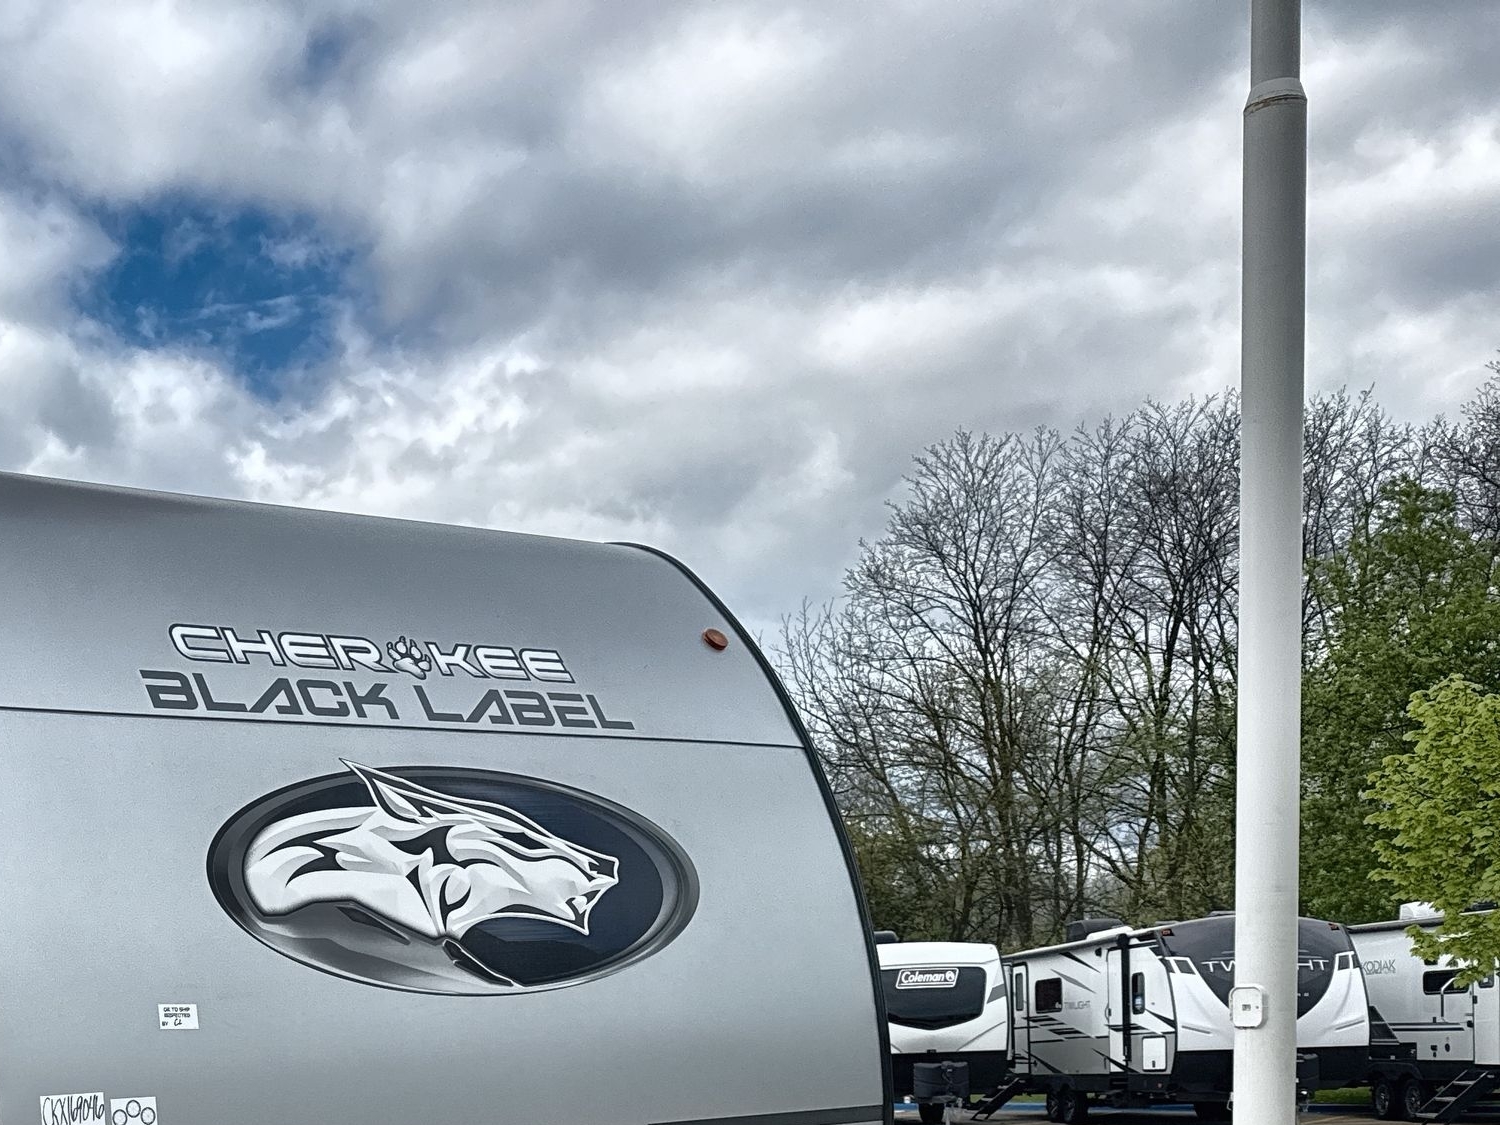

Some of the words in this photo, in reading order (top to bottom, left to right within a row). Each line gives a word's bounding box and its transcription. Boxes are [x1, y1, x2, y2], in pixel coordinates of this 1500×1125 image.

[139, 669, 402, 720] BLACK
[412, 684, 636, 730] LABEL
[901, 971, 945, 984] Coleman
